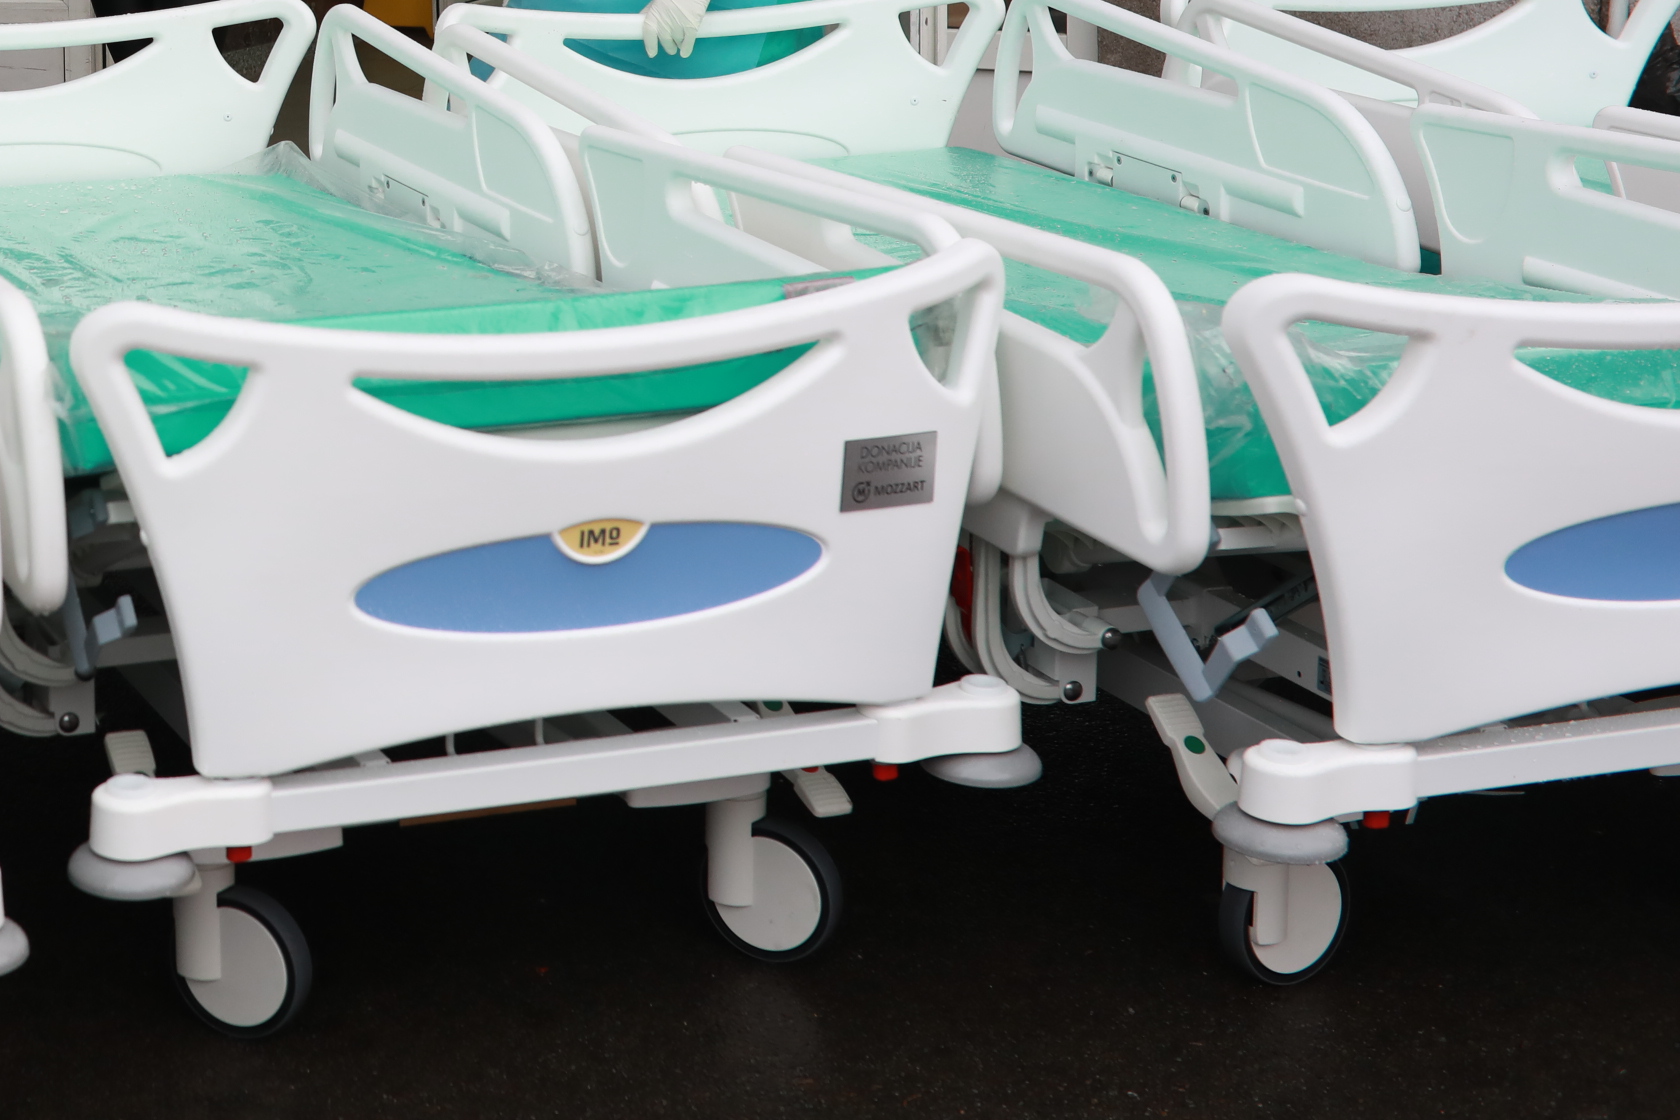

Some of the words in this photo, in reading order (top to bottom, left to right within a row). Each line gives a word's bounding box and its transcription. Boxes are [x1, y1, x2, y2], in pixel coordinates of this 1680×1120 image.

[860, 441, 923, 459] DONACIJA
[857, 455, 924, 474] KOMPANIJE
[873, 480, 926, 496] MOZZART
